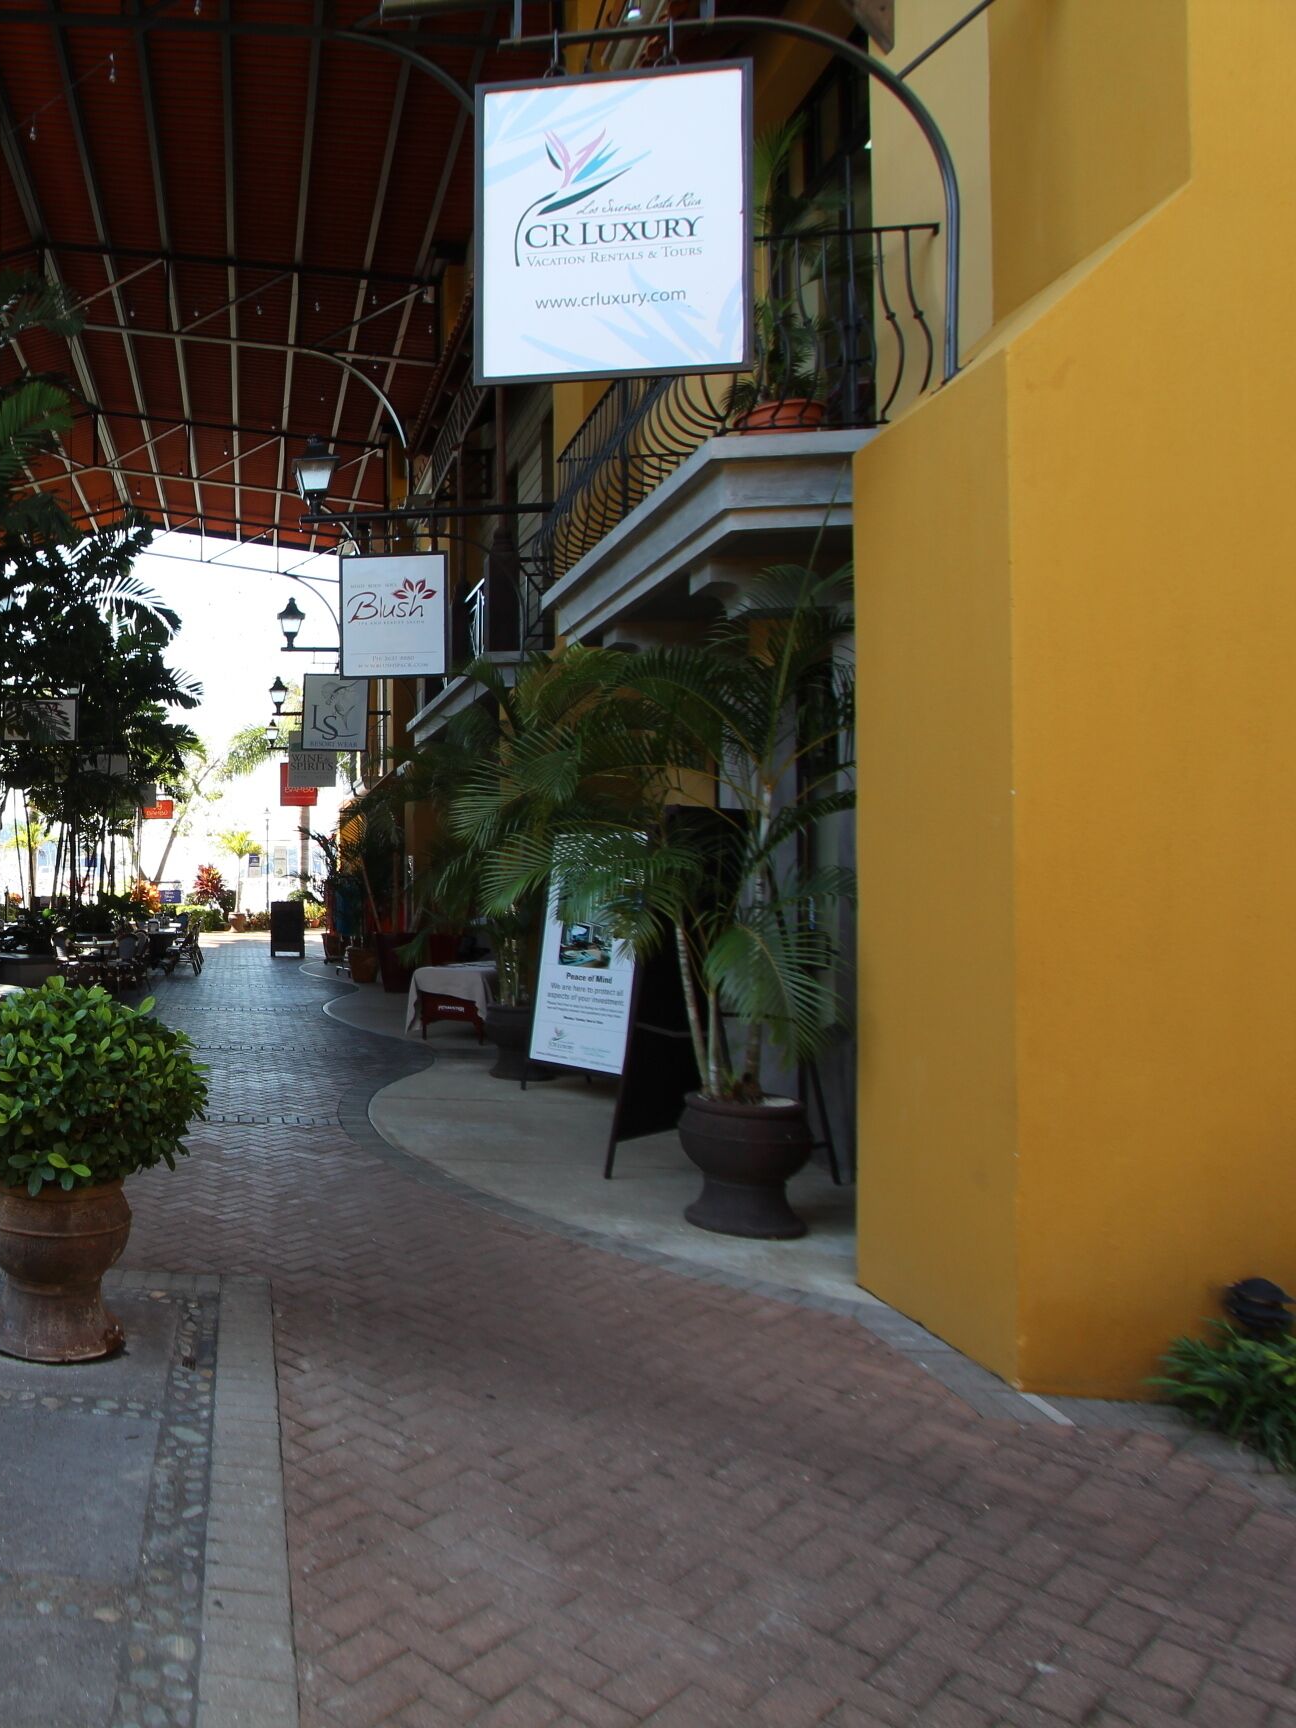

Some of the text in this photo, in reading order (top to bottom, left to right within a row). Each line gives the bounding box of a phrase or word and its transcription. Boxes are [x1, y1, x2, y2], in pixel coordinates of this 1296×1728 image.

[576, 200, 599, 216] Los
[646, 194, 673, 210] Costa
[525, 215, 704, 249] CR LUXURY
[525, 246, 703, 268] VACATION RENTALS & TOURS
[534, 287, 687, 310] www.crluxury.com
[347, 591, 424, 624] Blush
[310, 740, 335, 748] RESORT
[291, 753, 322, 763] WINE
[290, 762, 335, 771] SPIRITS
[566, 971, 613, 984] Peace of Mind
[550, 982, 561, 990] We
[573, 984, 586, 993] here
[547, 992, 570, 1000] aspects
[578, 995, 591, 1003] your
